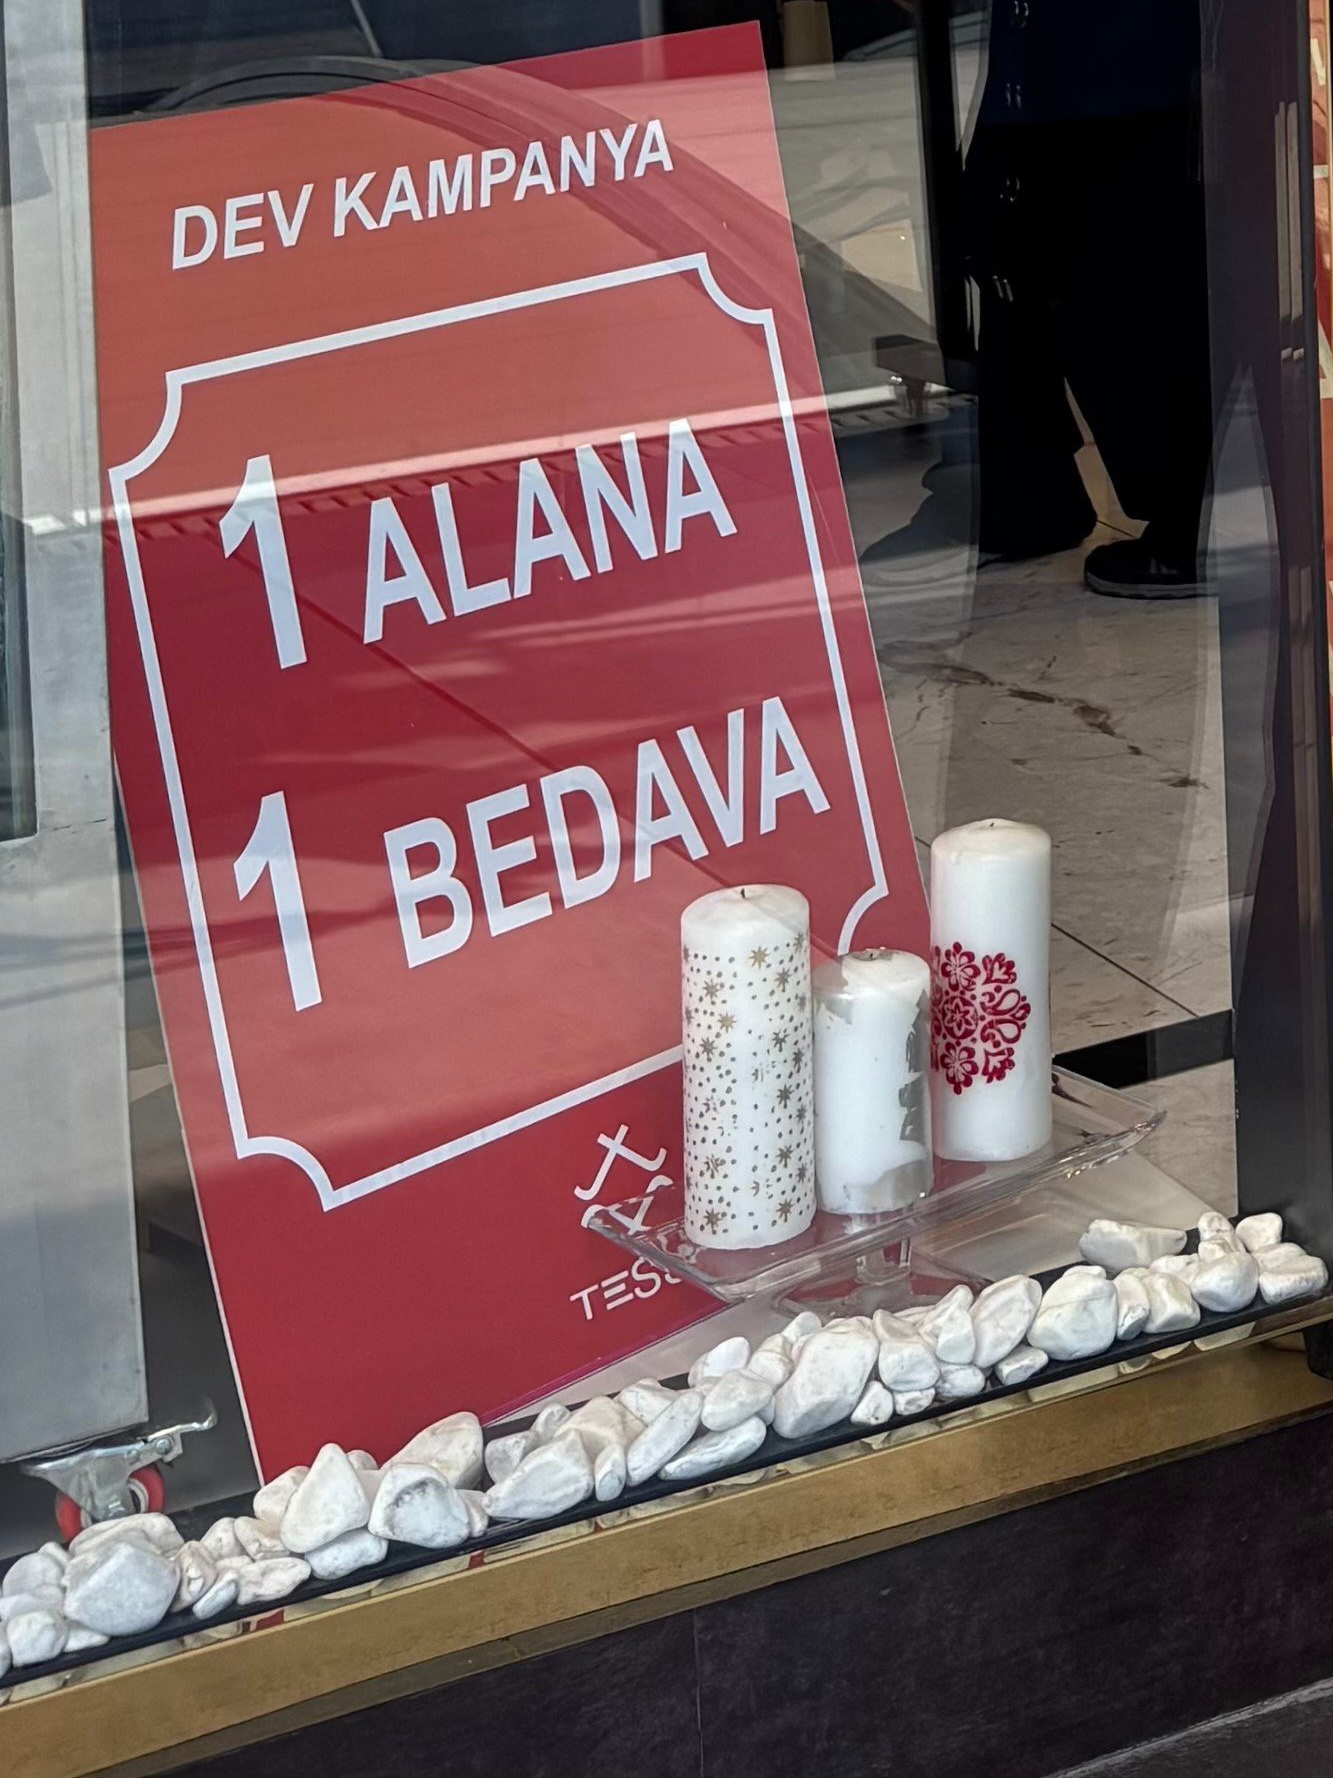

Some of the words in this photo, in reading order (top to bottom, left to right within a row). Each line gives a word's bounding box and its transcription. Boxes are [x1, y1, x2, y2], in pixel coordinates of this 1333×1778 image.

[171, 182, 315, 271] DEV
[332, 118, 675, 238] KAMPANYA
[219, 454, 308, 671] 1
[362, 418, 738, 645] ALANA
[232, 790, 324, 1013] 1
[382, 695, 832, 970] BEDAVA
[569, 1255, 683, 1321] TES
